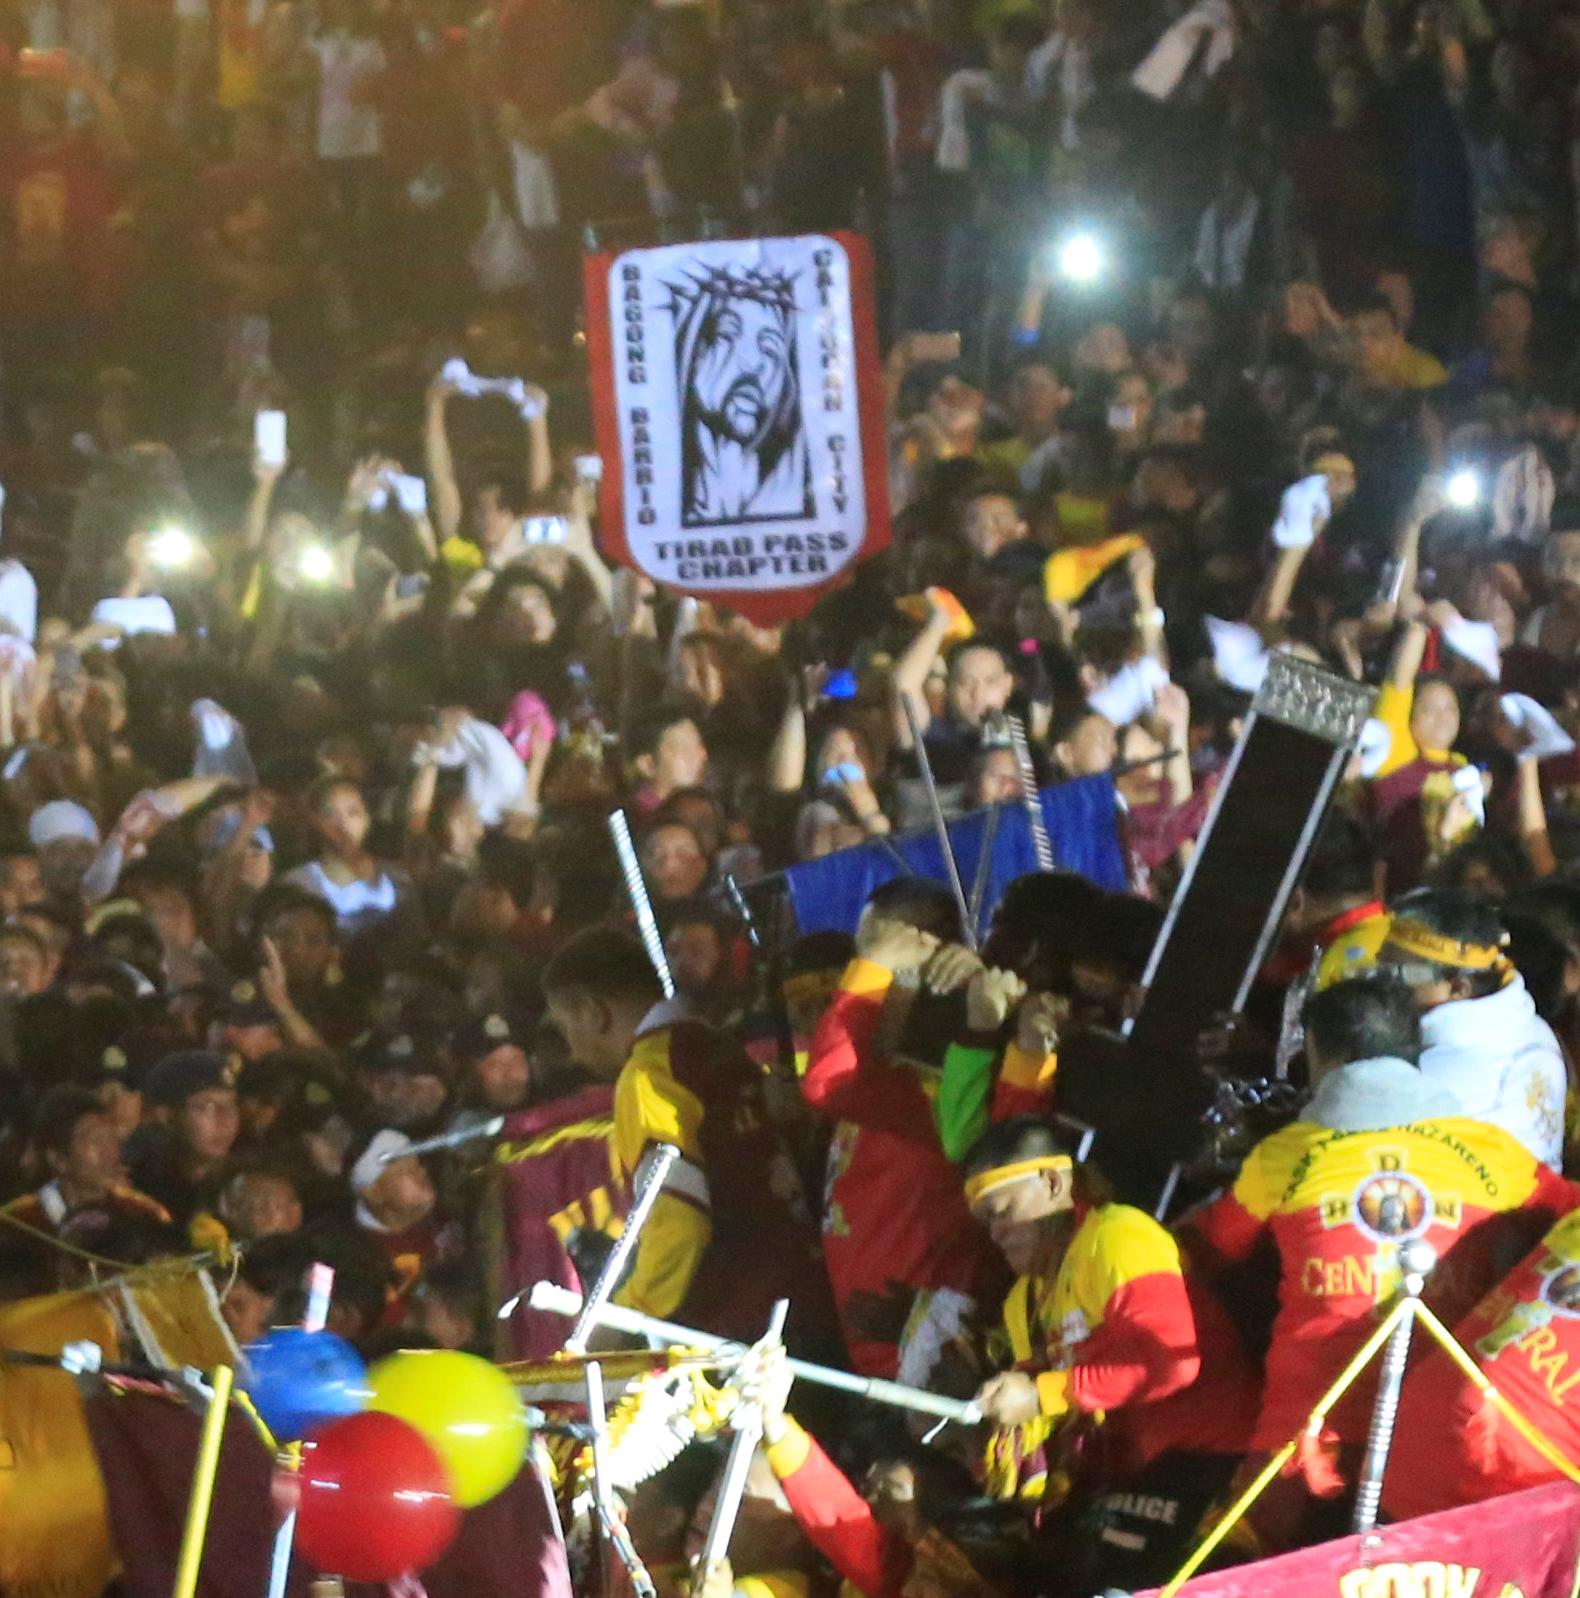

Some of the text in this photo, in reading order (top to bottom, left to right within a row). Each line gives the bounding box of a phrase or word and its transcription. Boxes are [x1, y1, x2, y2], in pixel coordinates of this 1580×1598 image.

[654, 532, 849, 560] TIRAD PASS
[678, 554, 827, 580] CHAPTER
